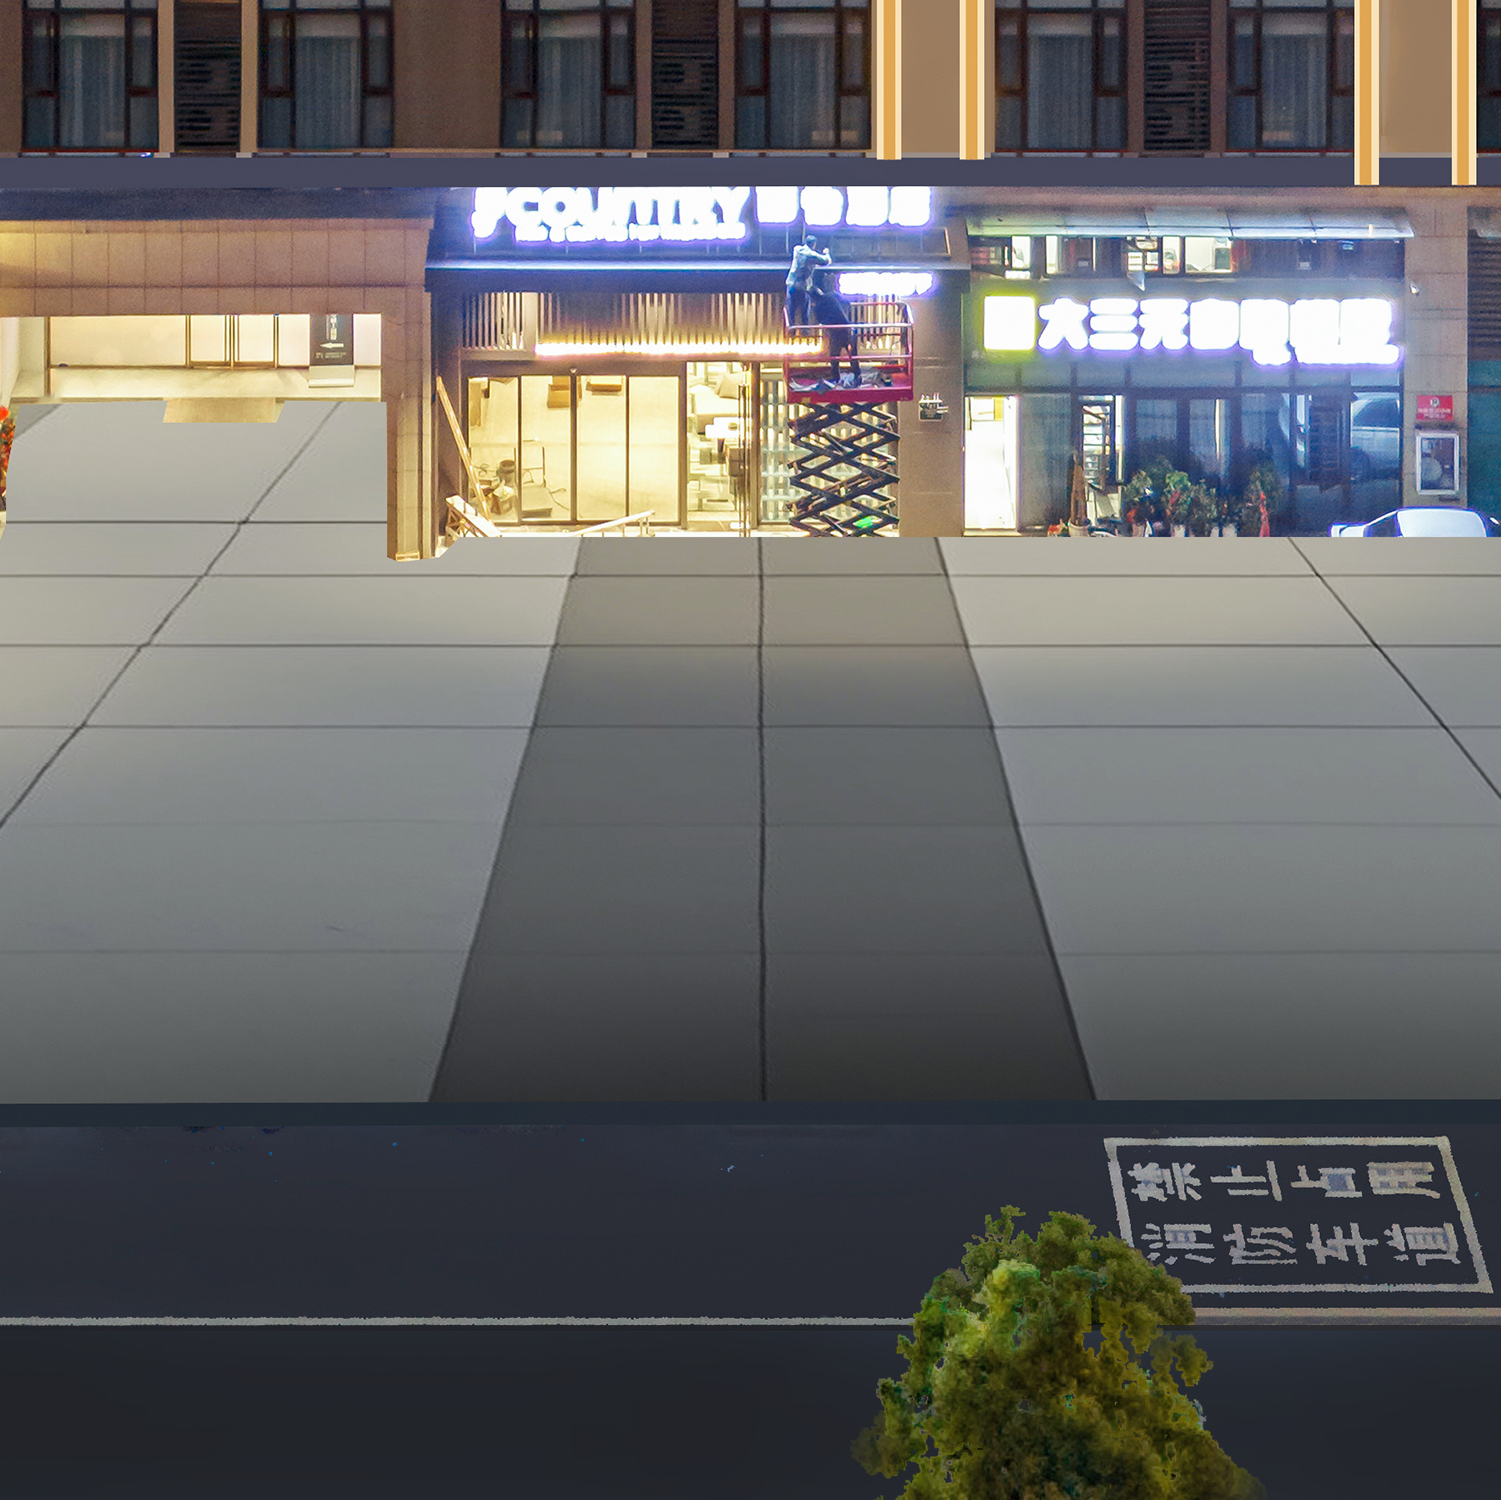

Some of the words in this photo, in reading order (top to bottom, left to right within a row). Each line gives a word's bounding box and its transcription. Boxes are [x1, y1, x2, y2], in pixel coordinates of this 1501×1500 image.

[1127, 1160, 1441, 1202] 禁止占用
[1140, 1221, 1462, 1266] 消防车道
